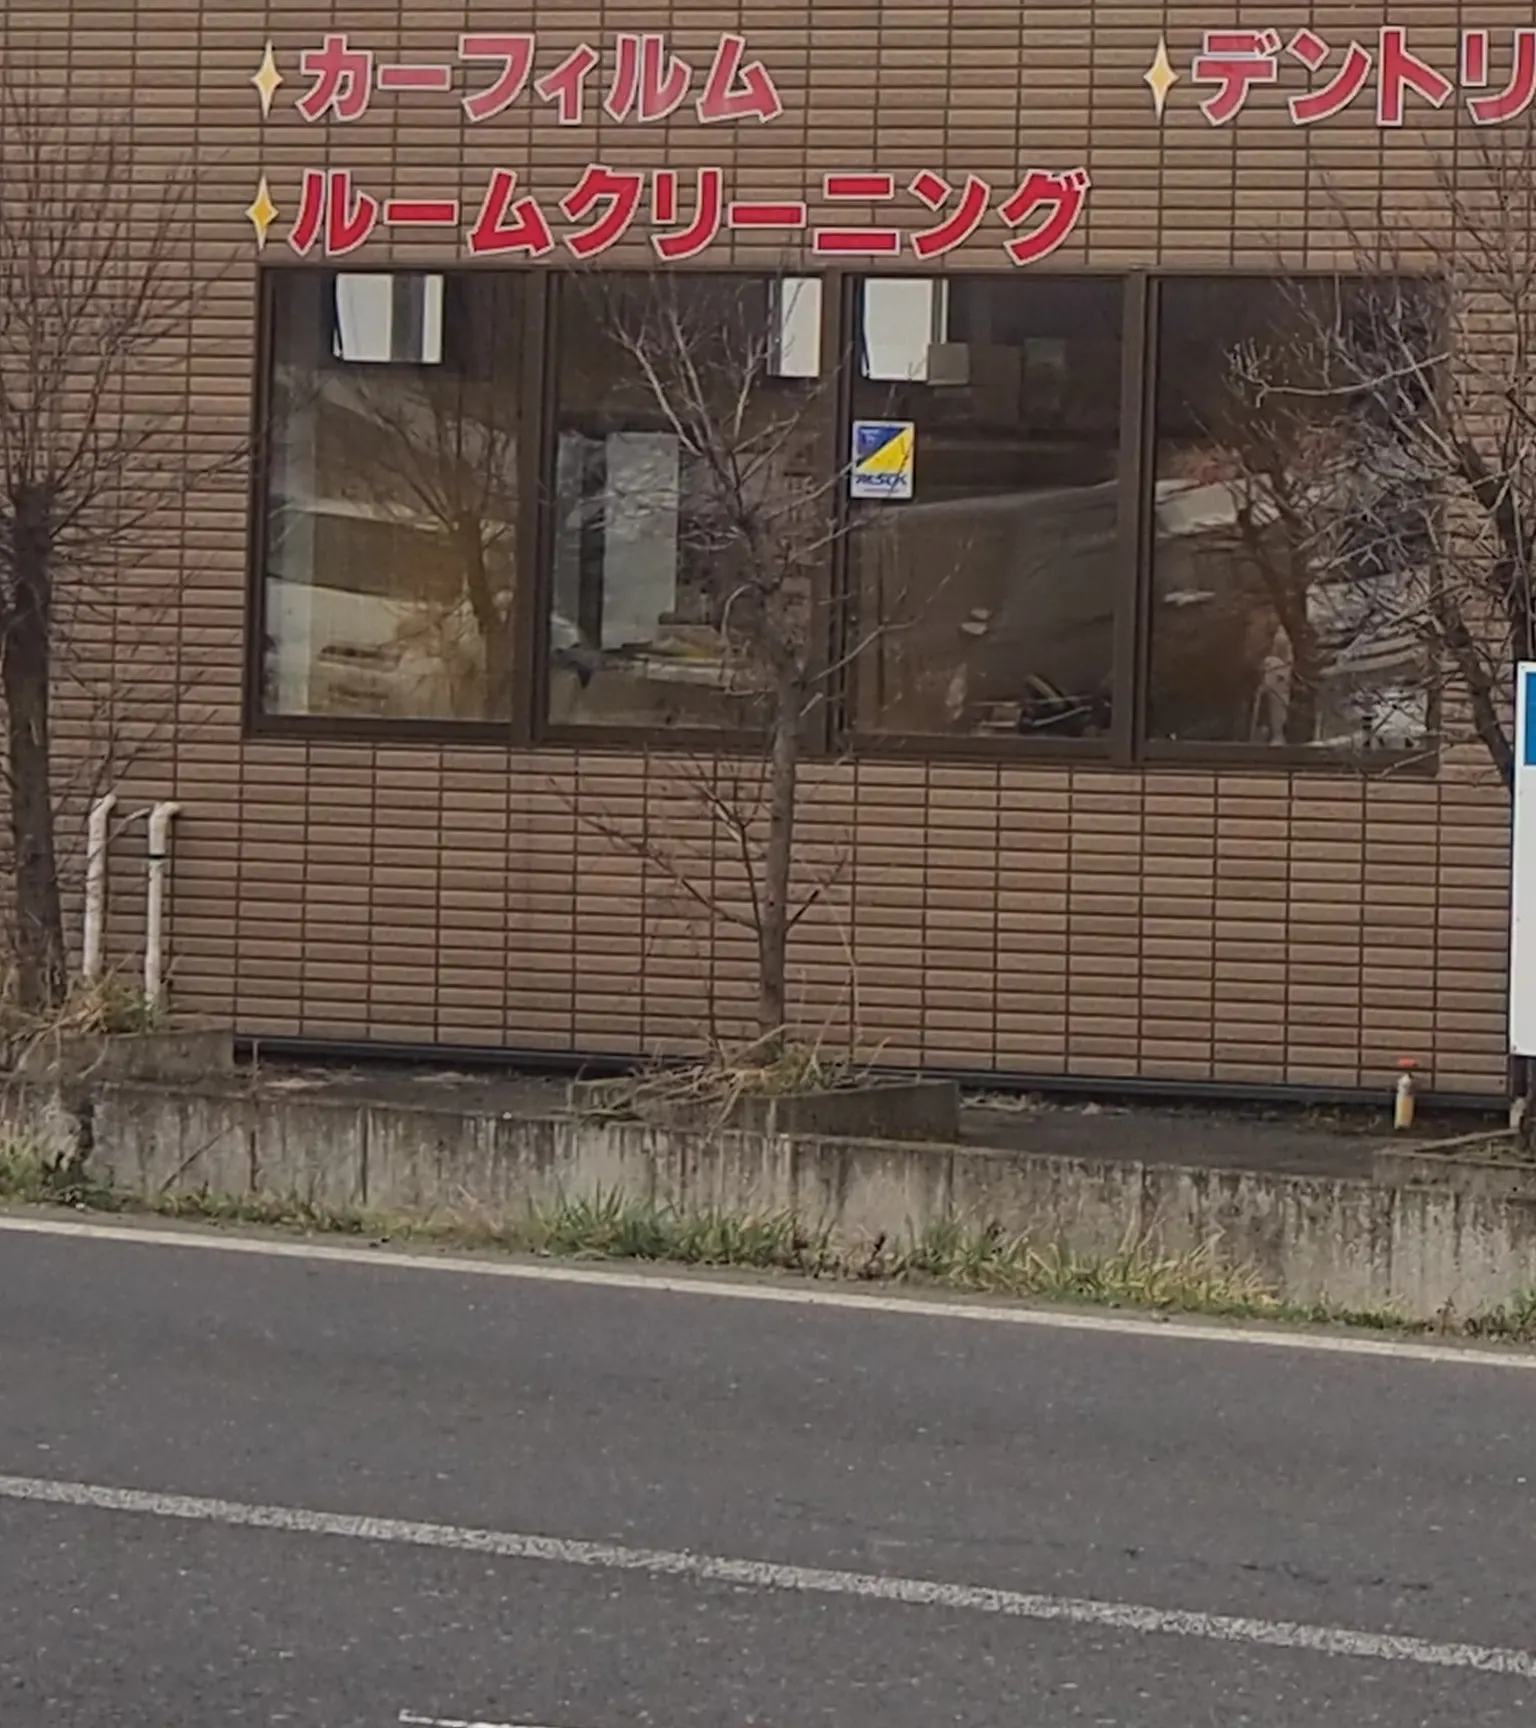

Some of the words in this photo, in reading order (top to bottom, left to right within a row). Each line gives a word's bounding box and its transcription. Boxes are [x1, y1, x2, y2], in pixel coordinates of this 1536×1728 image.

[297, 32, 782, 123] カーフィルム
[287, 163, 1091, 266] ルームクリーニング
